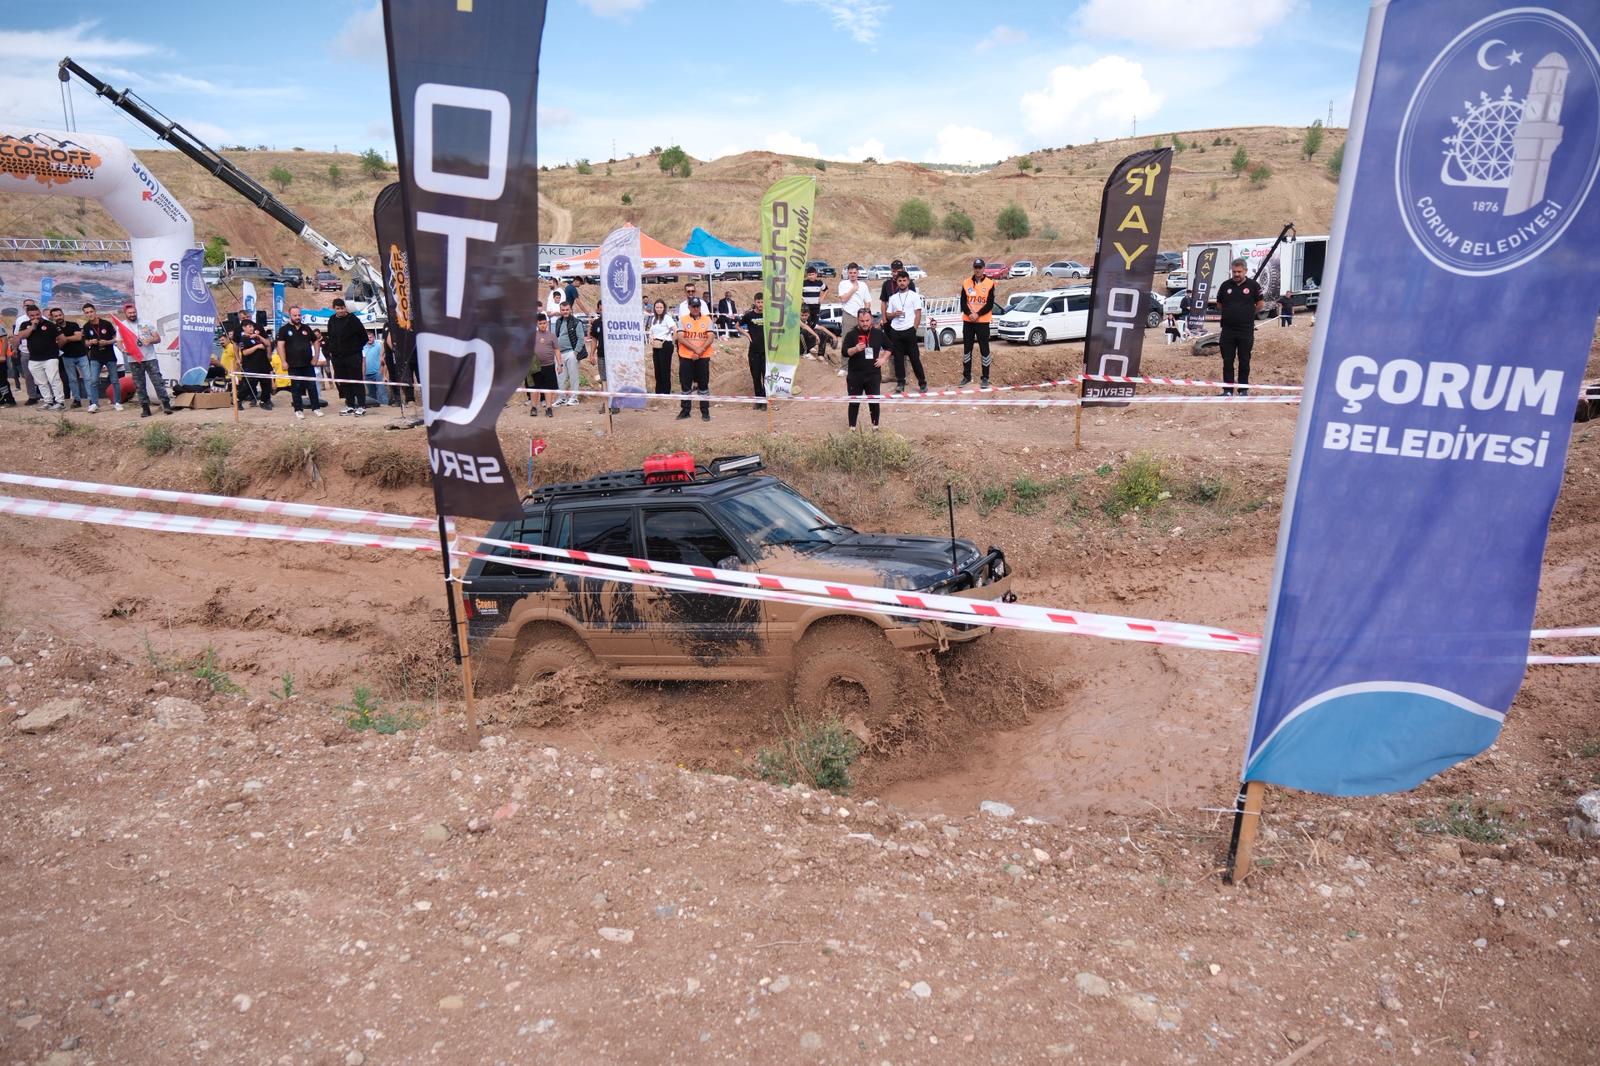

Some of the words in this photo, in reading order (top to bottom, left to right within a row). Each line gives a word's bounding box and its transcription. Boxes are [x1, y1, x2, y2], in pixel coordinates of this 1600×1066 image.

[1472, 201, 1499, 212] 1876
[1417, 196, 1459, 248] ÇORUM
[1460, 200, 1563, 256] BELEDİYESİ
[183, 315, 215, 324] ÇORUM
[607, 320, 640, 332] ÇORUM
[1336, 355, 1564, 415] ÇORUM
[1322, 421, 1550, 468] BELEDİYESİ
